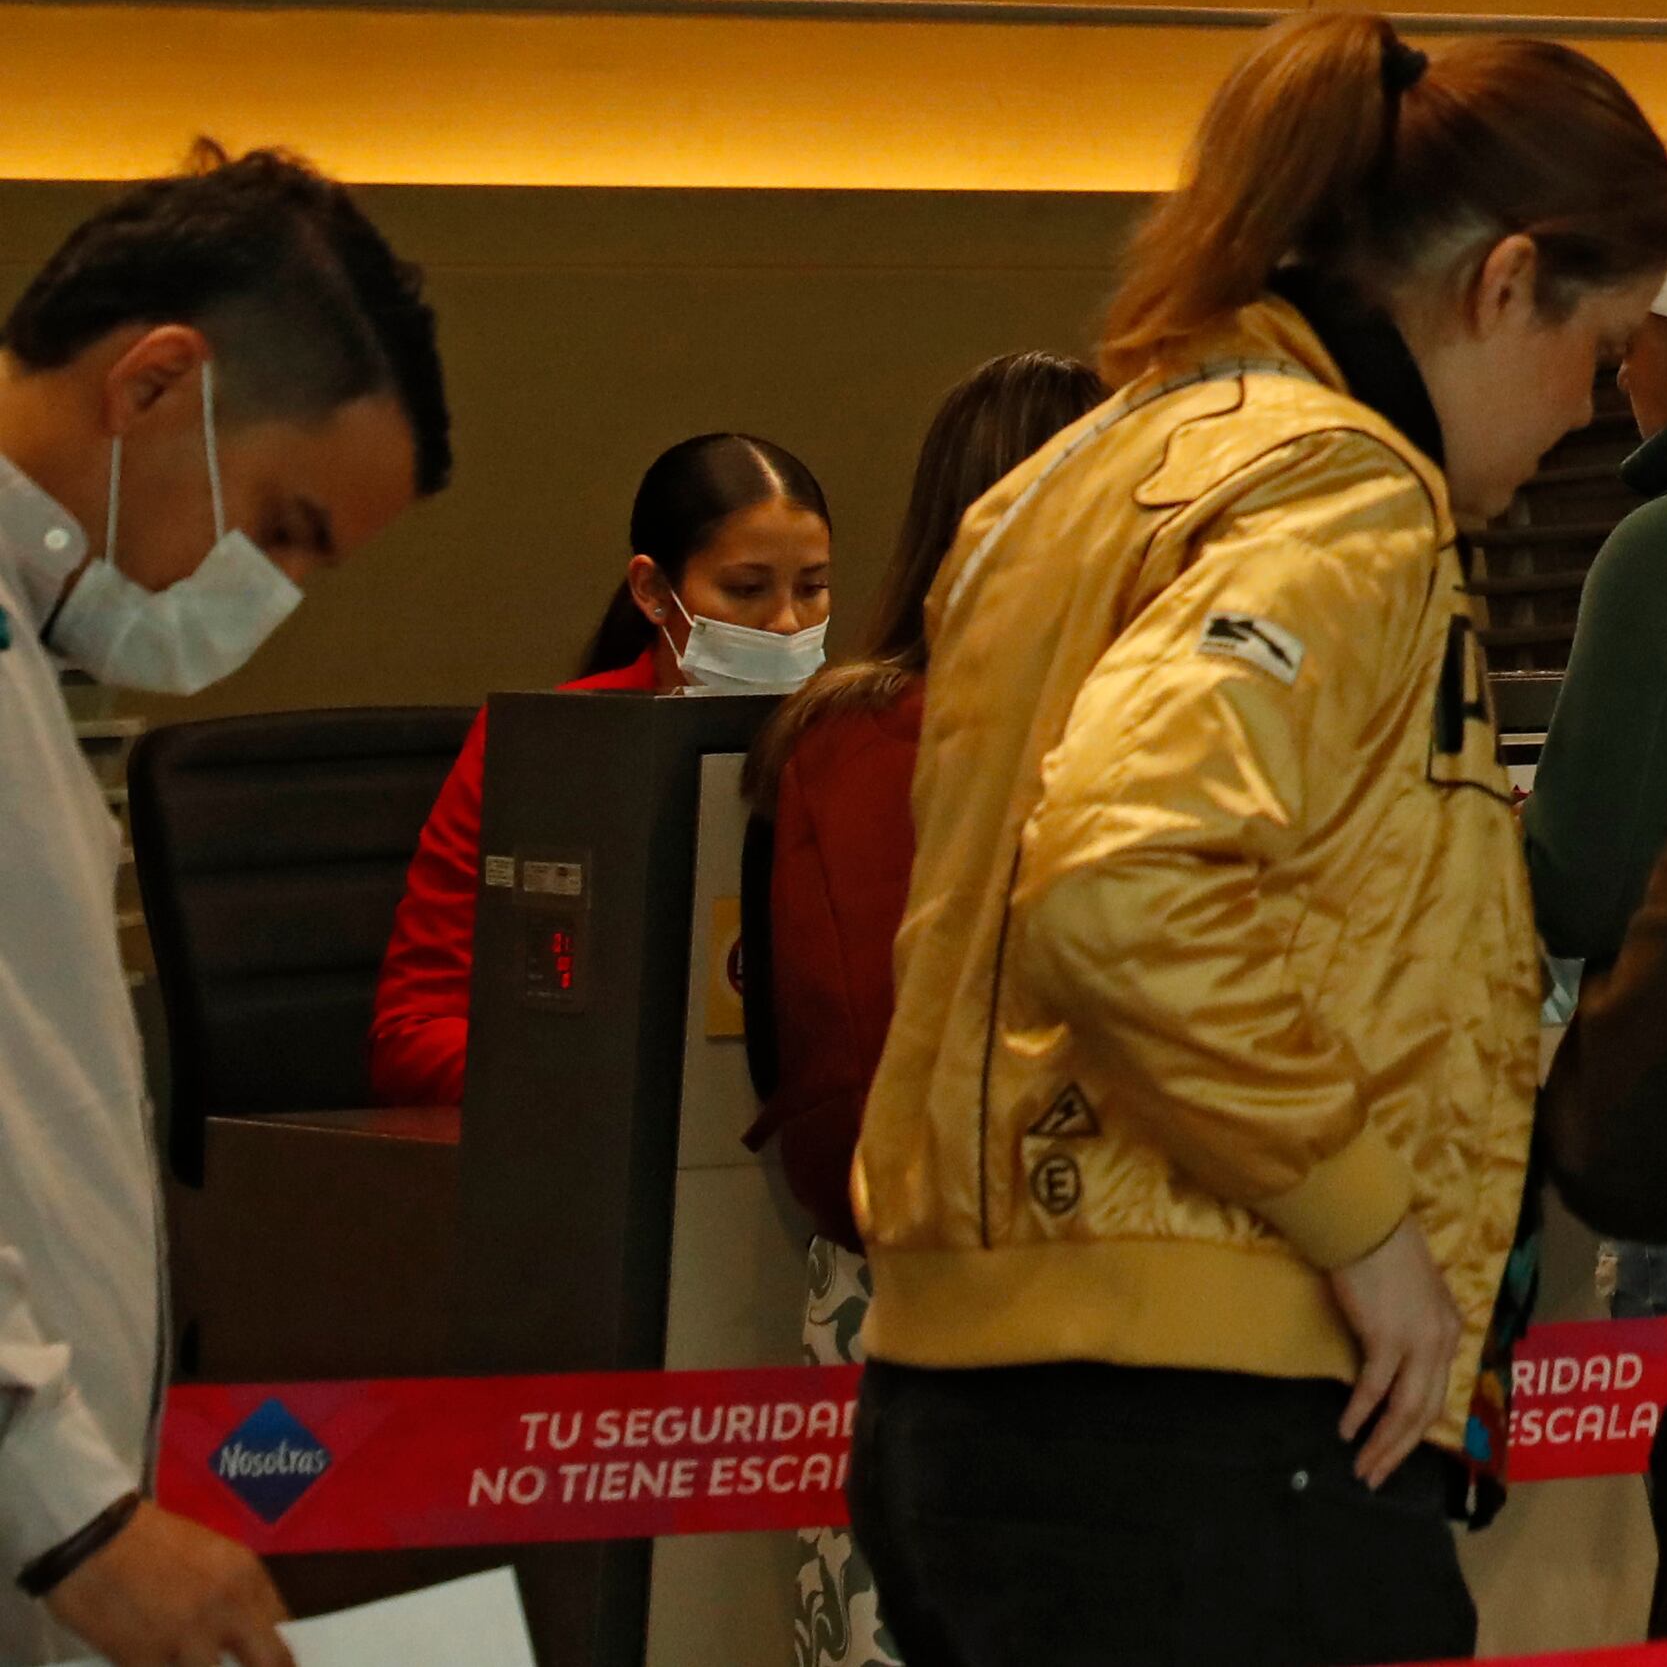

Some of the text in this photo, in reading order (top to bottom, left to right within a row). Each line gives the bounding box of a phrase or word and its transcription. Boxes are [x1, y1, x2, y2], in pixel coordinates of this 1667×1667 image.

[522, 1413, 582, 1450] TU
[219, 1437, 325, 1480] Nosotras
[469, 1466, 546, 1505] NO
[560, 1458, 698, 1502] TIENE
